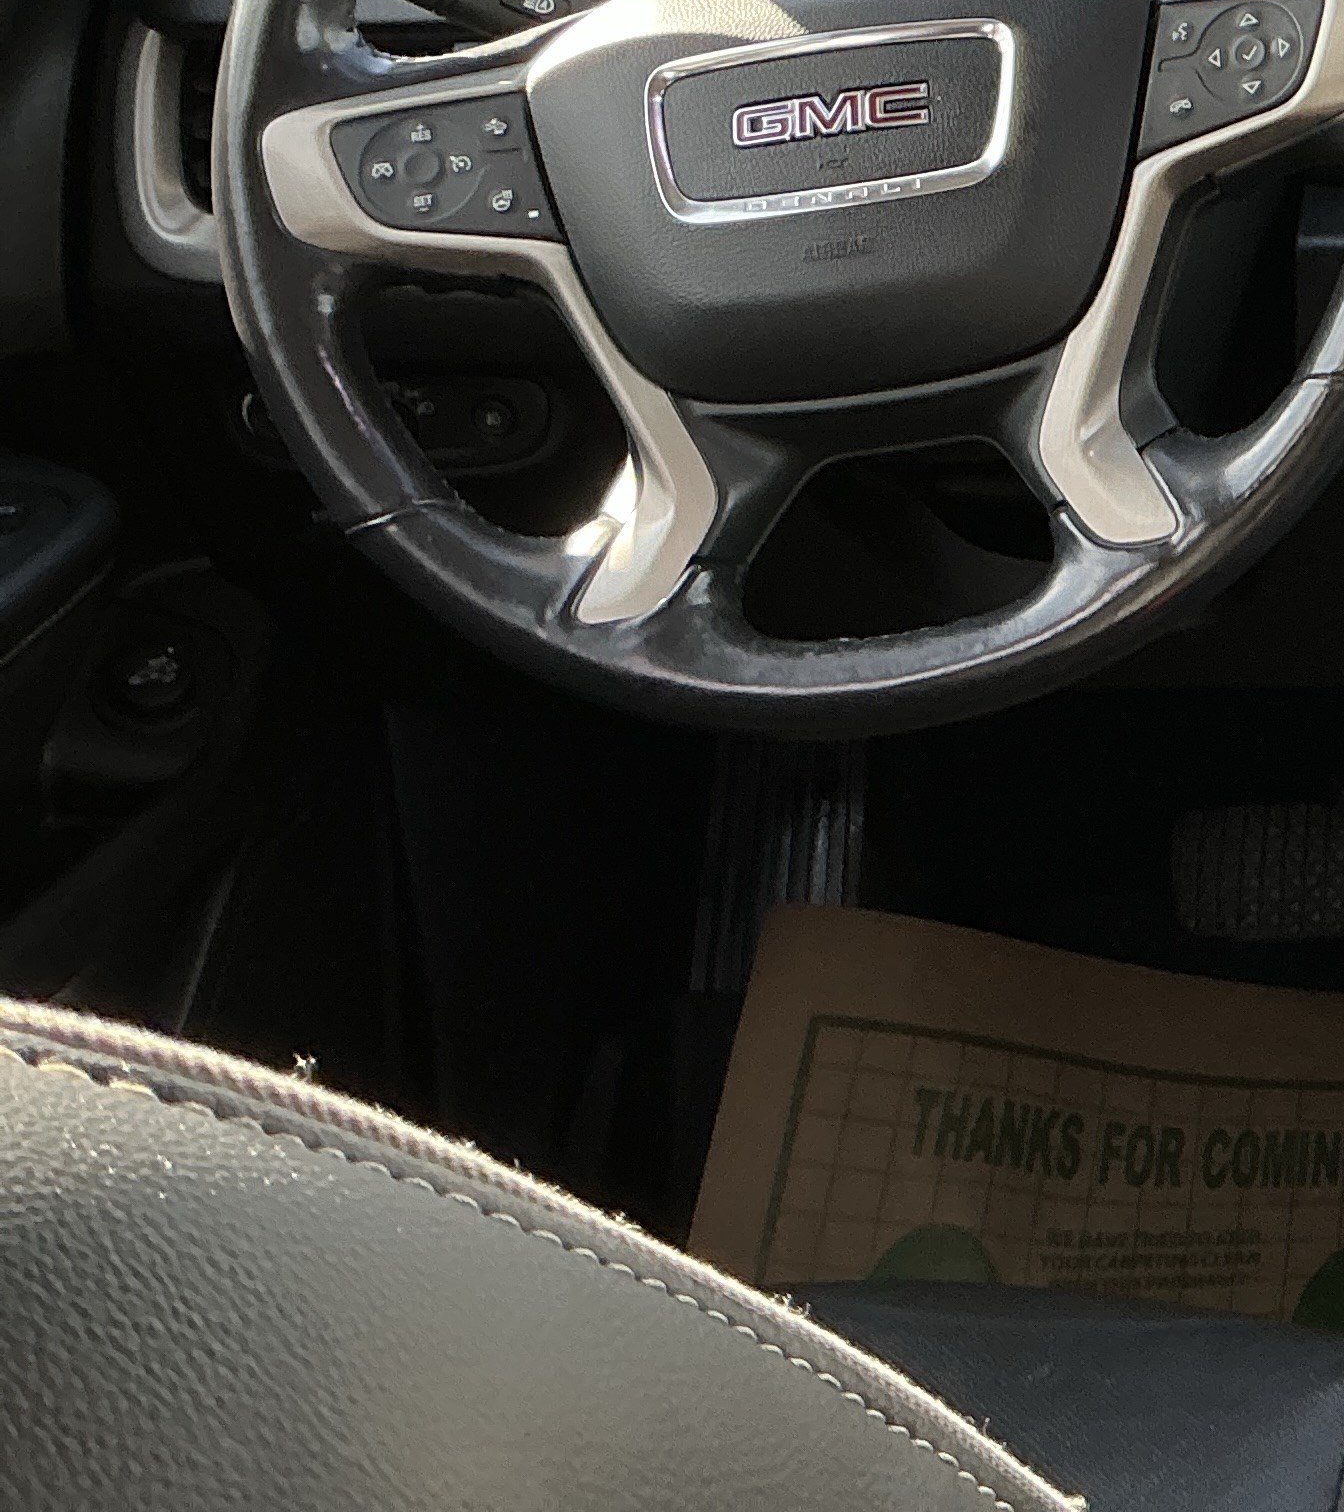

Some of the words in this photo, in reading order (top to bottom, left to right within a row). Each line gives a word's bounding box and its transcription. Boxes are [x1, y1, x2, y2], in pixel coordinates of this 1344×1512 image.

[732, 82, 930, 150] GMC
[409, 130, 433, 144] RES
[412, 194, 433, 208] SET
[912, 1086, 1087, 1183] THANKS
[1098, 1118, 1185, 1191] FOR
